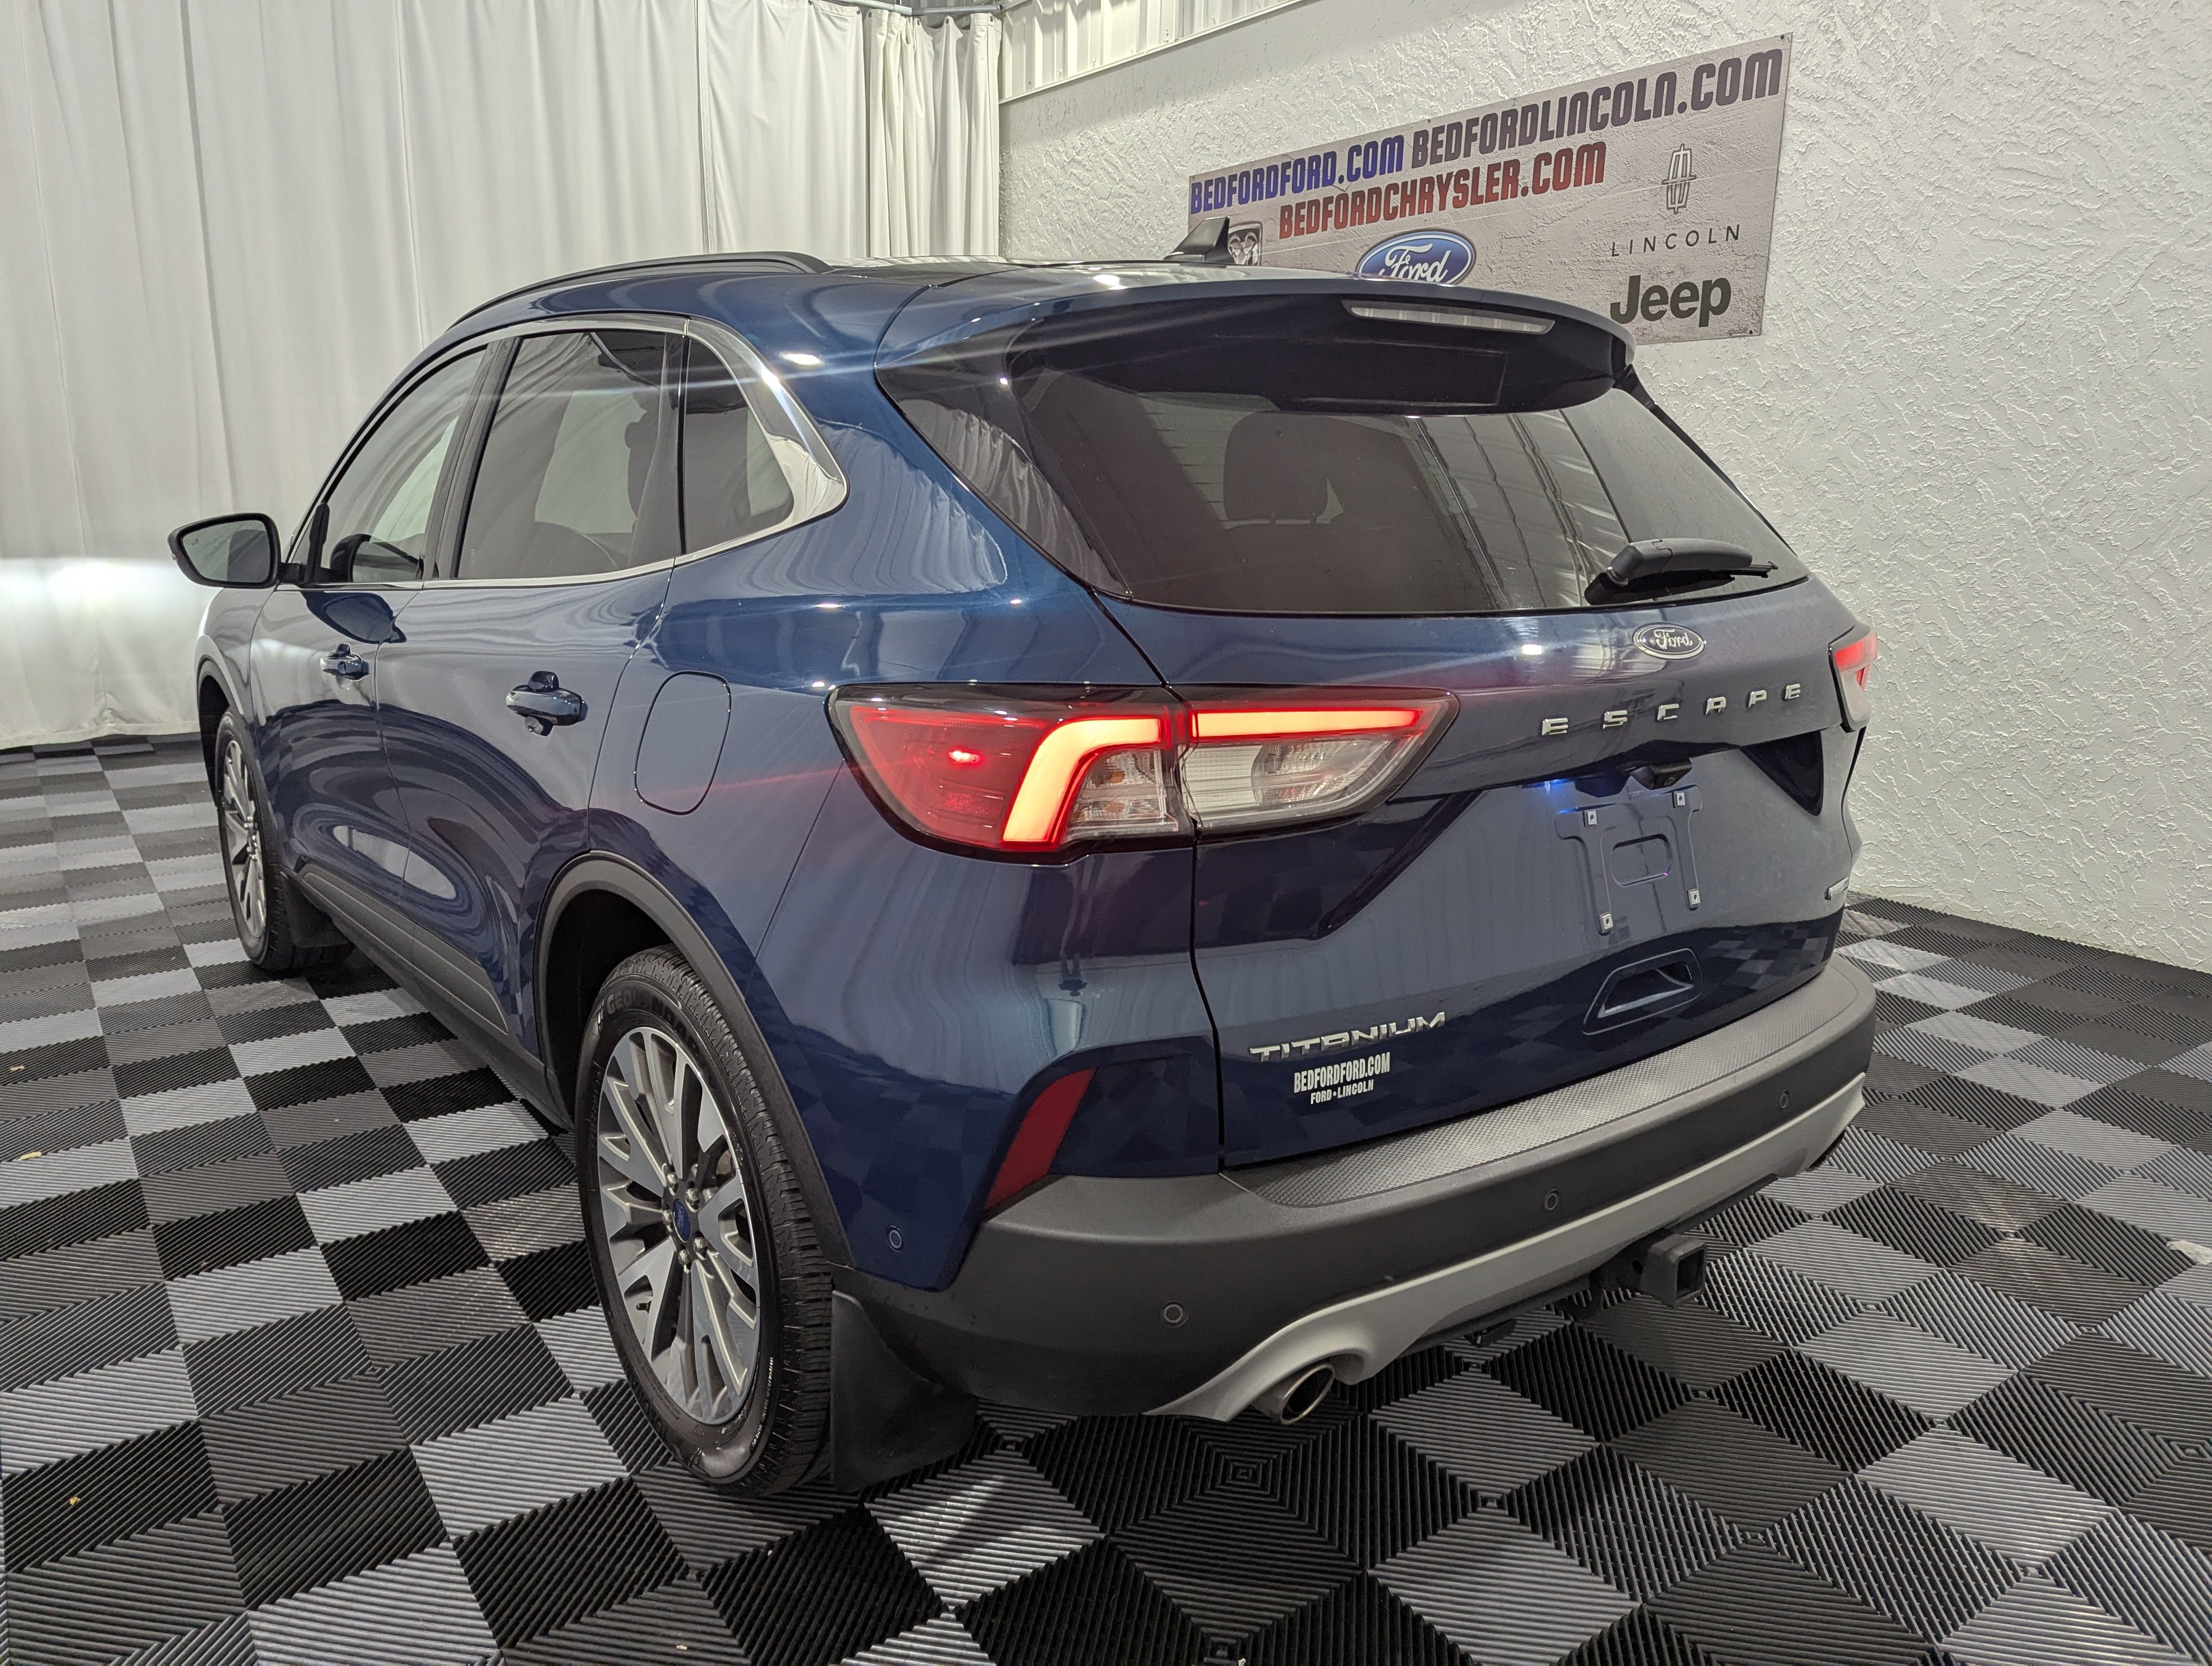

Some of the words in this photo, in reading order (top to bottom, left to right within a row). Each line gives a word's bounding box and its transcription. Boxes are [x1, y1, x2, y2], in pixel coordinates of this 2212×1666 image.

[1191, 135, 1404, 215] BEDFORDFORD.COM
[1411, 49, 1783, 169] BEDFORDLINCOLN.COM
[1279, 141, 1607, 239] BEDFORDCHRYSLER.COM
[1379, 243, 1451, 283] Ford
[1611, 224, 1740, 257] LINCOLN
[1610, 275, 1732, 328] Jeep
[1654, 629, 1693, 649] Ford
[1542, 683, 1801, 736] ESCAPE
[1250, 1011, 1445, 1062] TITANIUM
[1294, 1052, 1390, 1093] BEDFORDFORD.COM
